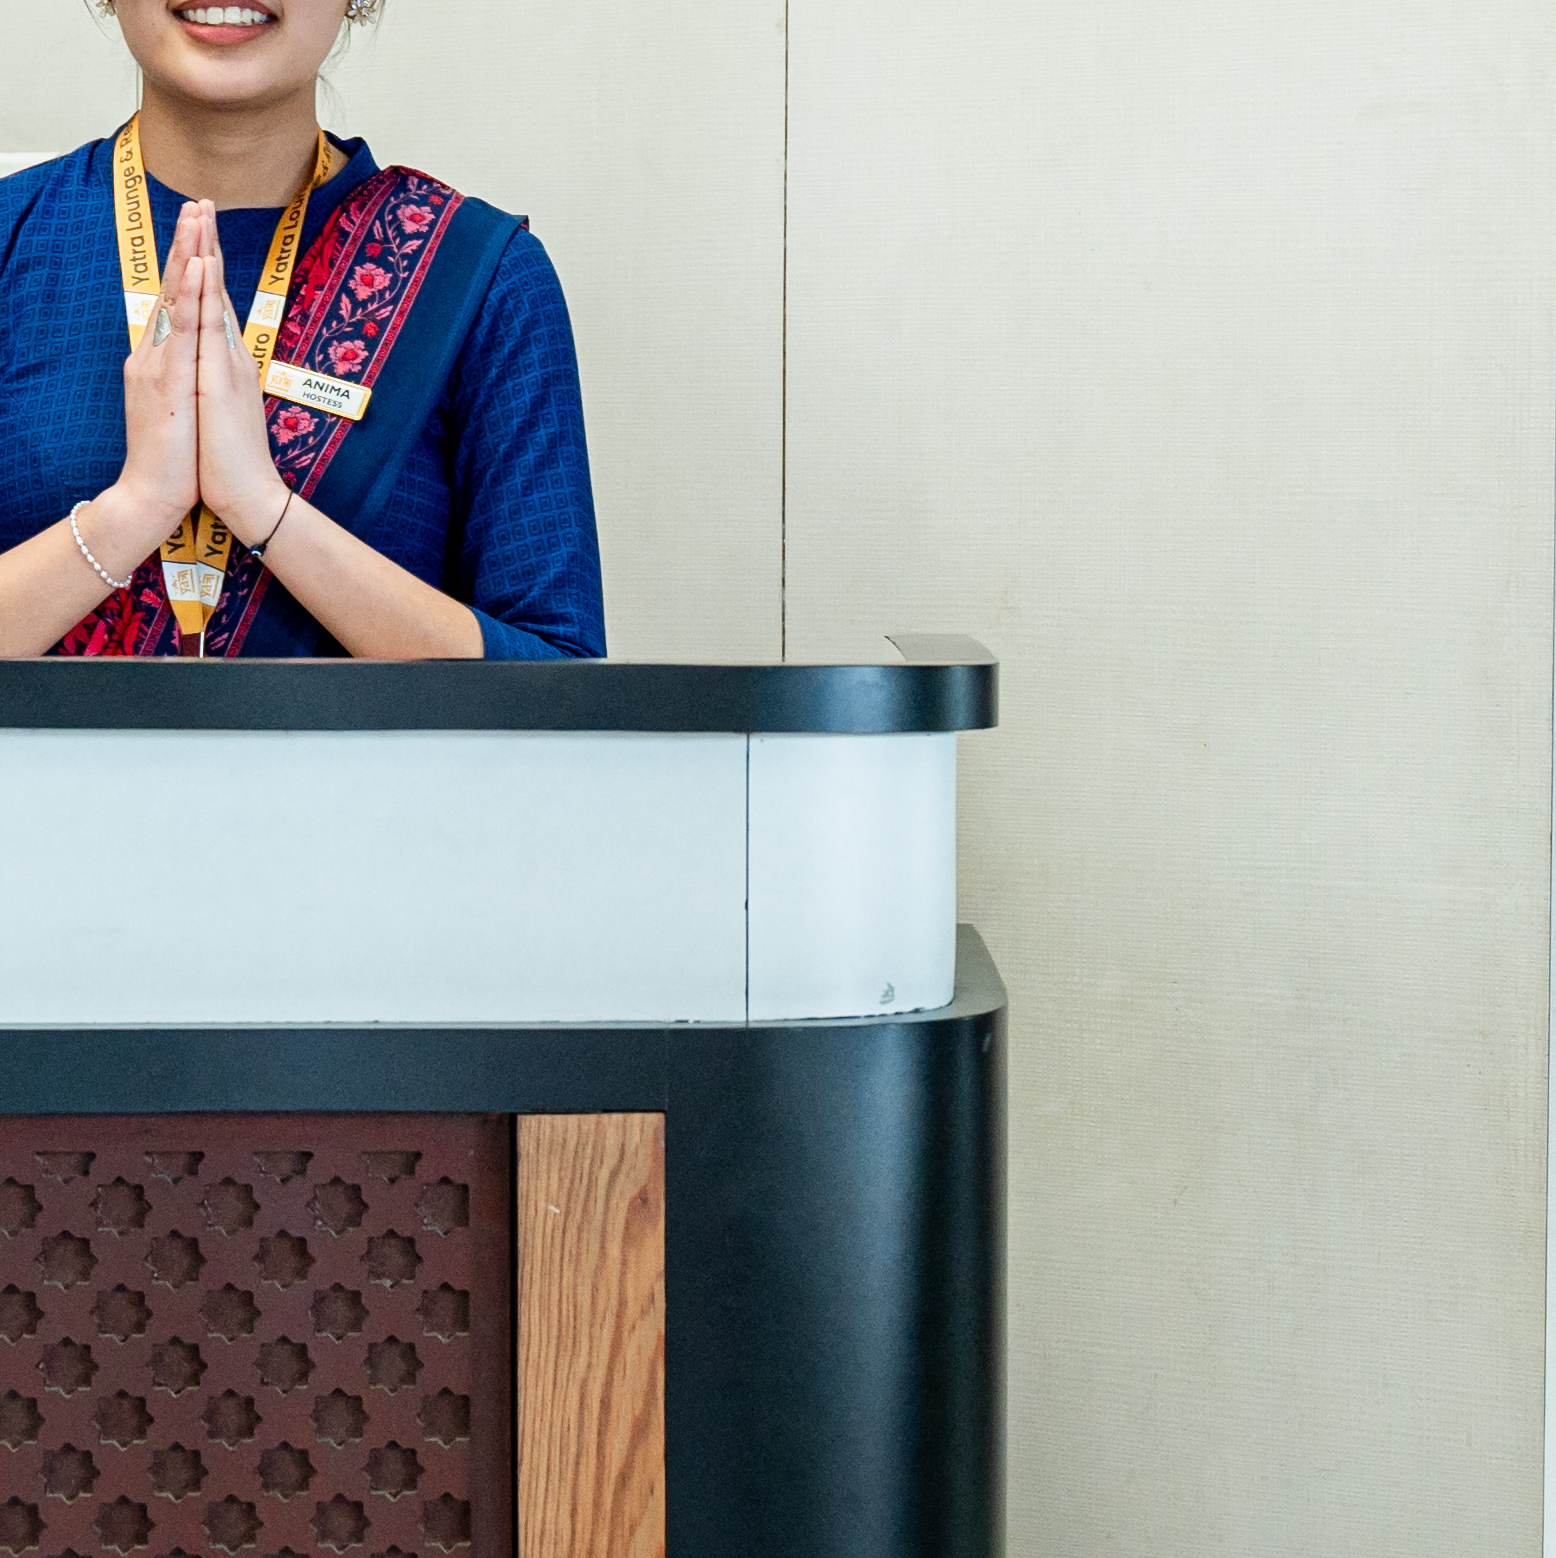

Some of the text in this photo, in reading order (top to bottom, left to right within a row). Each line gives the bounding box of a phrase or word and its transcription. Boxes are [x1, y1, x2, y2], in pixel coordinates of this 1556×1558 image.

[119, 146, 134, 163] &
[123, 166, 143, 232] Lounge
[129, 236, 150, 287] Yatra
[268, 234, 295, 286] Yatra
[302, 378, 351, 400] ANIMA
[302, 391, 343, 409] HOSTESS
